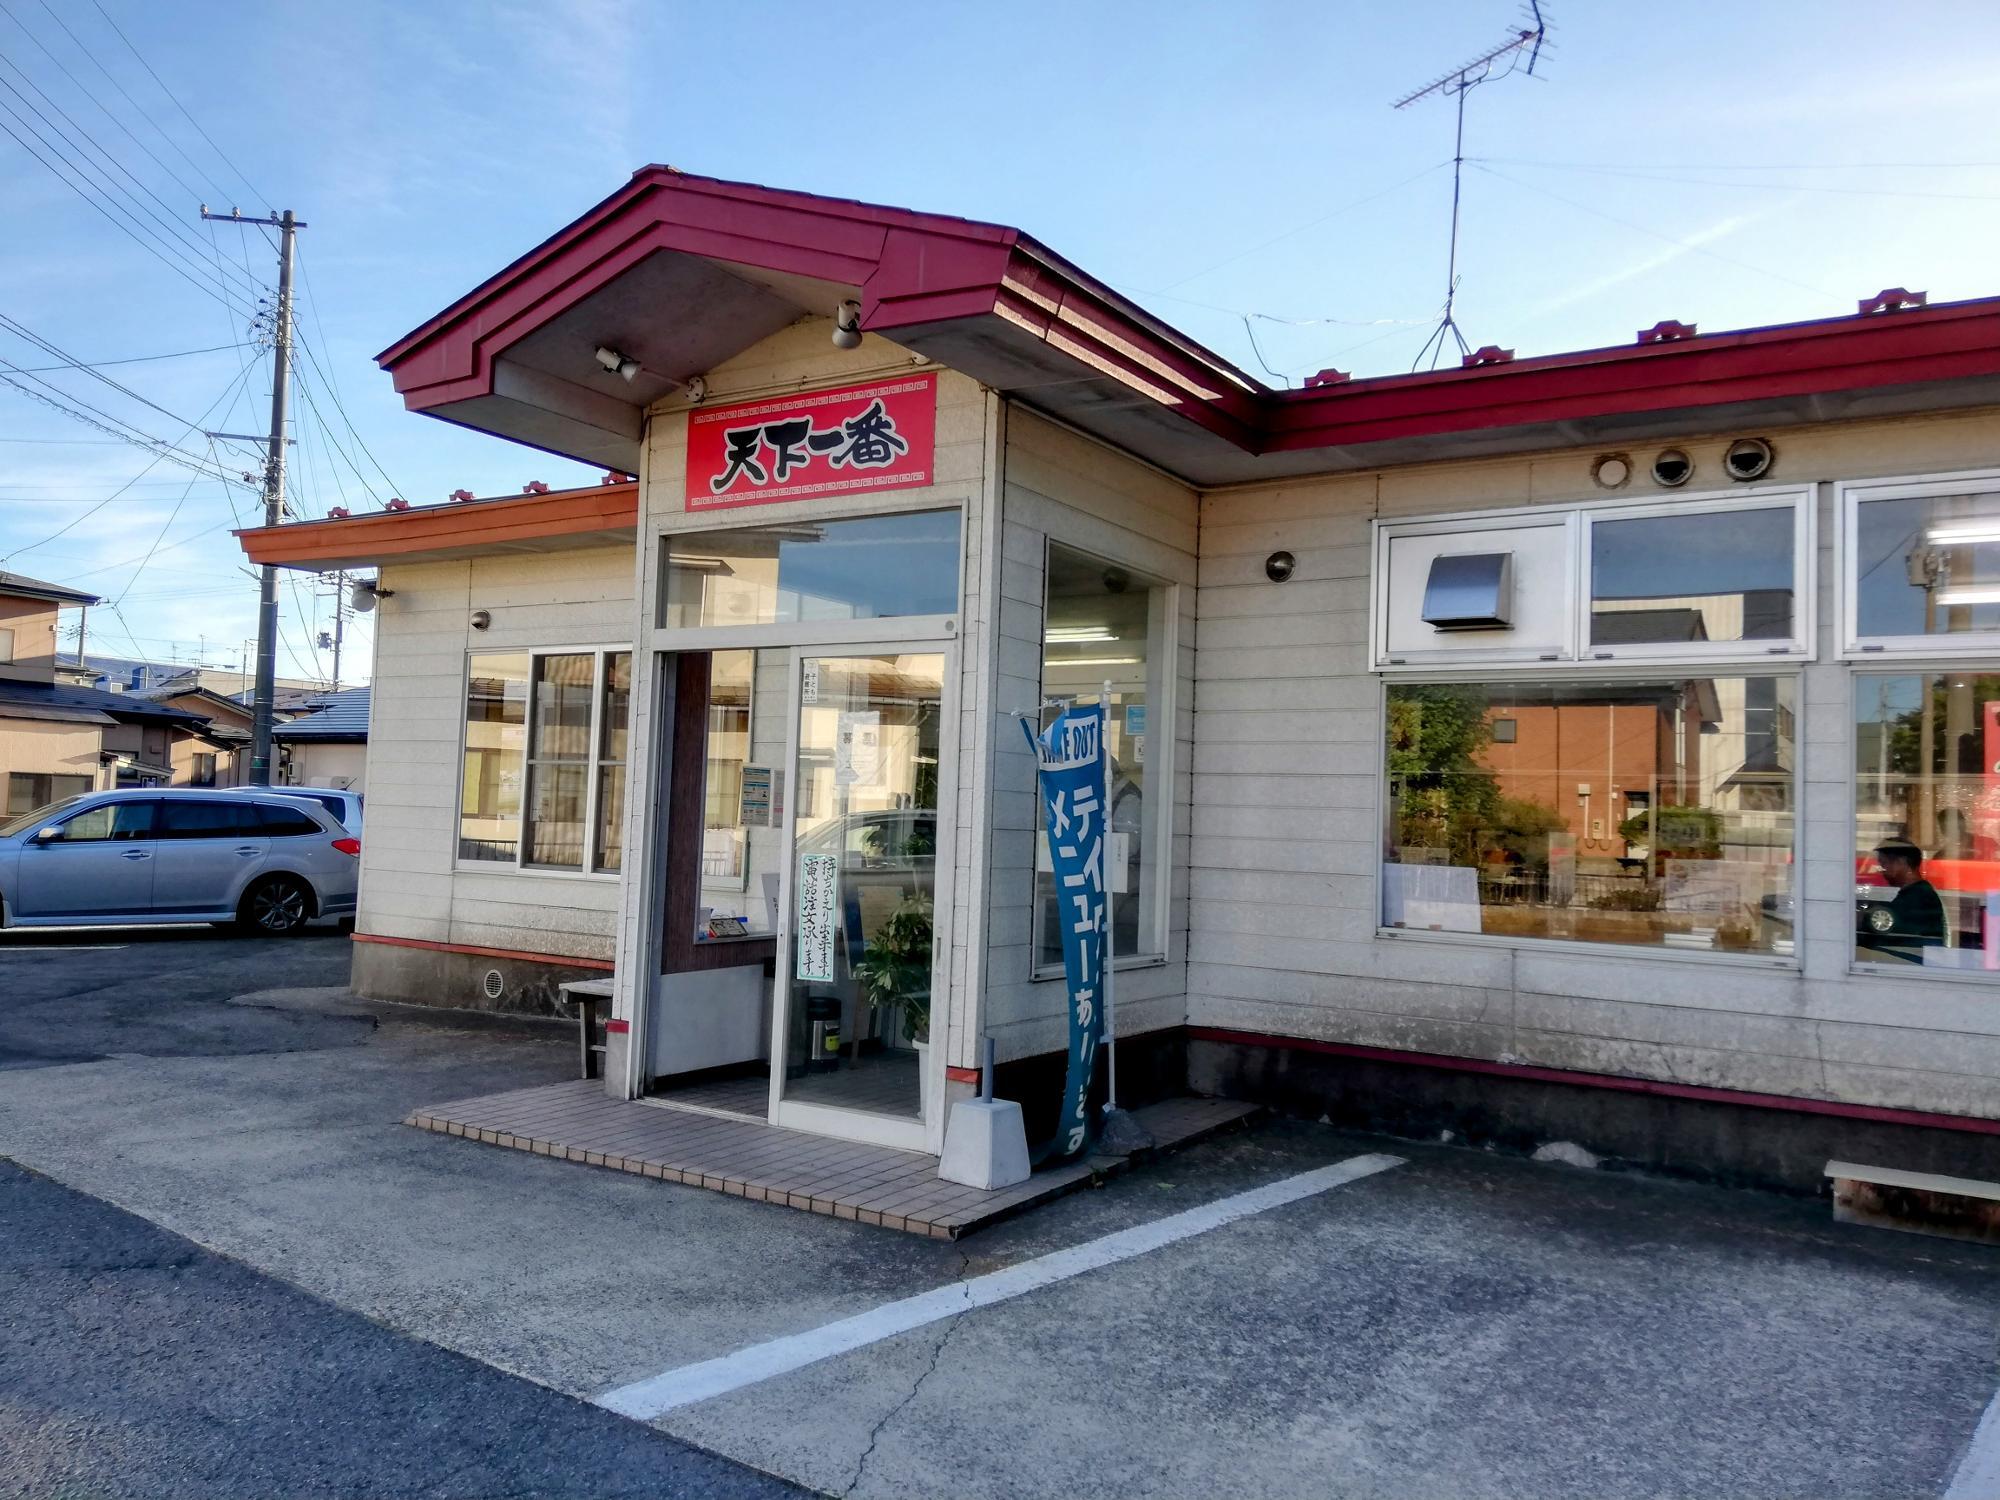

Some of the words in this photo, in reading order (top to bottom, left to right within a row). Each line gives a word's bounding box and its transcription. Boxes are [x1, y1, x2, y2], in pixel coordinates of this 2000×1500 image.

[710, 398, 909, 494] 天下一番
[1073, 721, 1096, 761] OUT
